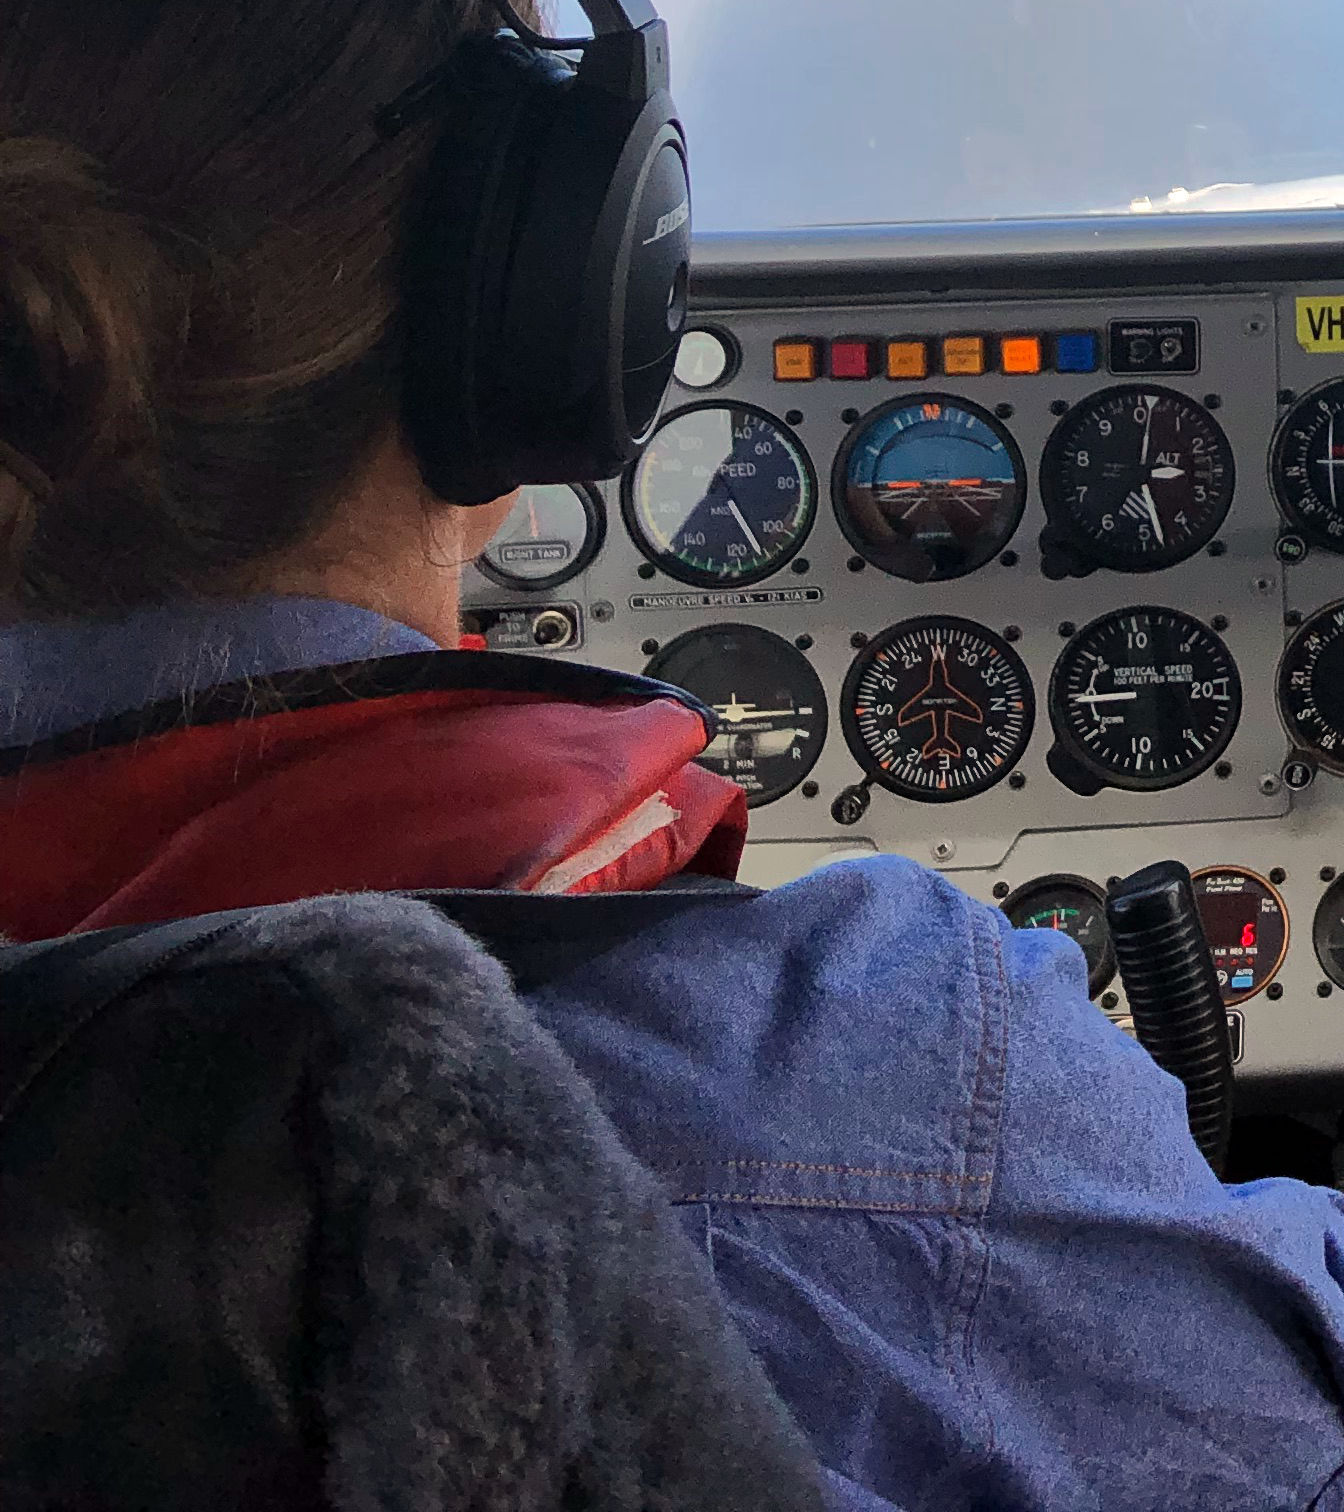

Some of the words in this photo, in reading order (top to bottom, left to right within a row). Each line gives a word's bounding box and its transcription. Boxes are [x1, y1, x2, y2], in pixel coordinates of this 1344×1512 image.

[735, 427, 752, 439] 40
[1099, 420, 1112, 436] 9
[755, 443, 772, 455] 60
[1192, 438, 1204, 454] 2
[1077, 451, 1090, 467] 8
[1156, 452, 1180, 465] ALT
[777, 477, 795, 489] 80
[1076, 486, 1088, 503] 7
[1194, 485, 1207, 501] 3
[1102, 514, 1115, 530] 6
[1174, 510, 1187, 526] 4
[763, 520, 784, 533] 100
[1139, 524, 1150, 541] 5
[684, 533, 705, 547] 140
[727, 544, 747, 557] 120
[643, 595, 704, 607] MANOEUVRE
[708, 593, 741, 605] SPEED
[784, 590, 807, 601] KIAS
[507, 622, 520, 632] TO
[1128, 632, 1148, 648] 10
[1304, 634, 1320, 651] 24
[1179, 643, 1191, 653] 15
[901, 651, 922, 669] 24
[958, 648, 979, 666] 30
[981, 666, 1001, 687] 33
[1114, 666, 1157, 676] VERTICAL
[1164, 664, 1193, 674] SPEED
[882, 674, 898, 691] 21
[1114, 676, 1126, 685] 100
[1128, 676, 1147, 685] FEET
[1149, 675, 1165, 684] PER
[1167, 674, 1193, 683] MINUTE
[1291, 671, 1304, 685] 21
[1191, 681, 1213, 699] 20
[876, 703, 893, 716] S
[990, 697, 1006, 711] N
[1297, 708, 1311, 721] S
[884, 728, 900, 745] 15
[986, 726, 1000, 737] 3
[1182, 729, 1194, 738] 15
[1131, 736, 1151, 754] 10
[1320, 734, 1336, 750] 15
[793, 747, 801, 759] R
[906, 748, 922, 764] 12
[736, 759, 755, 769] MIN
[939, 754, 950, 769] E
